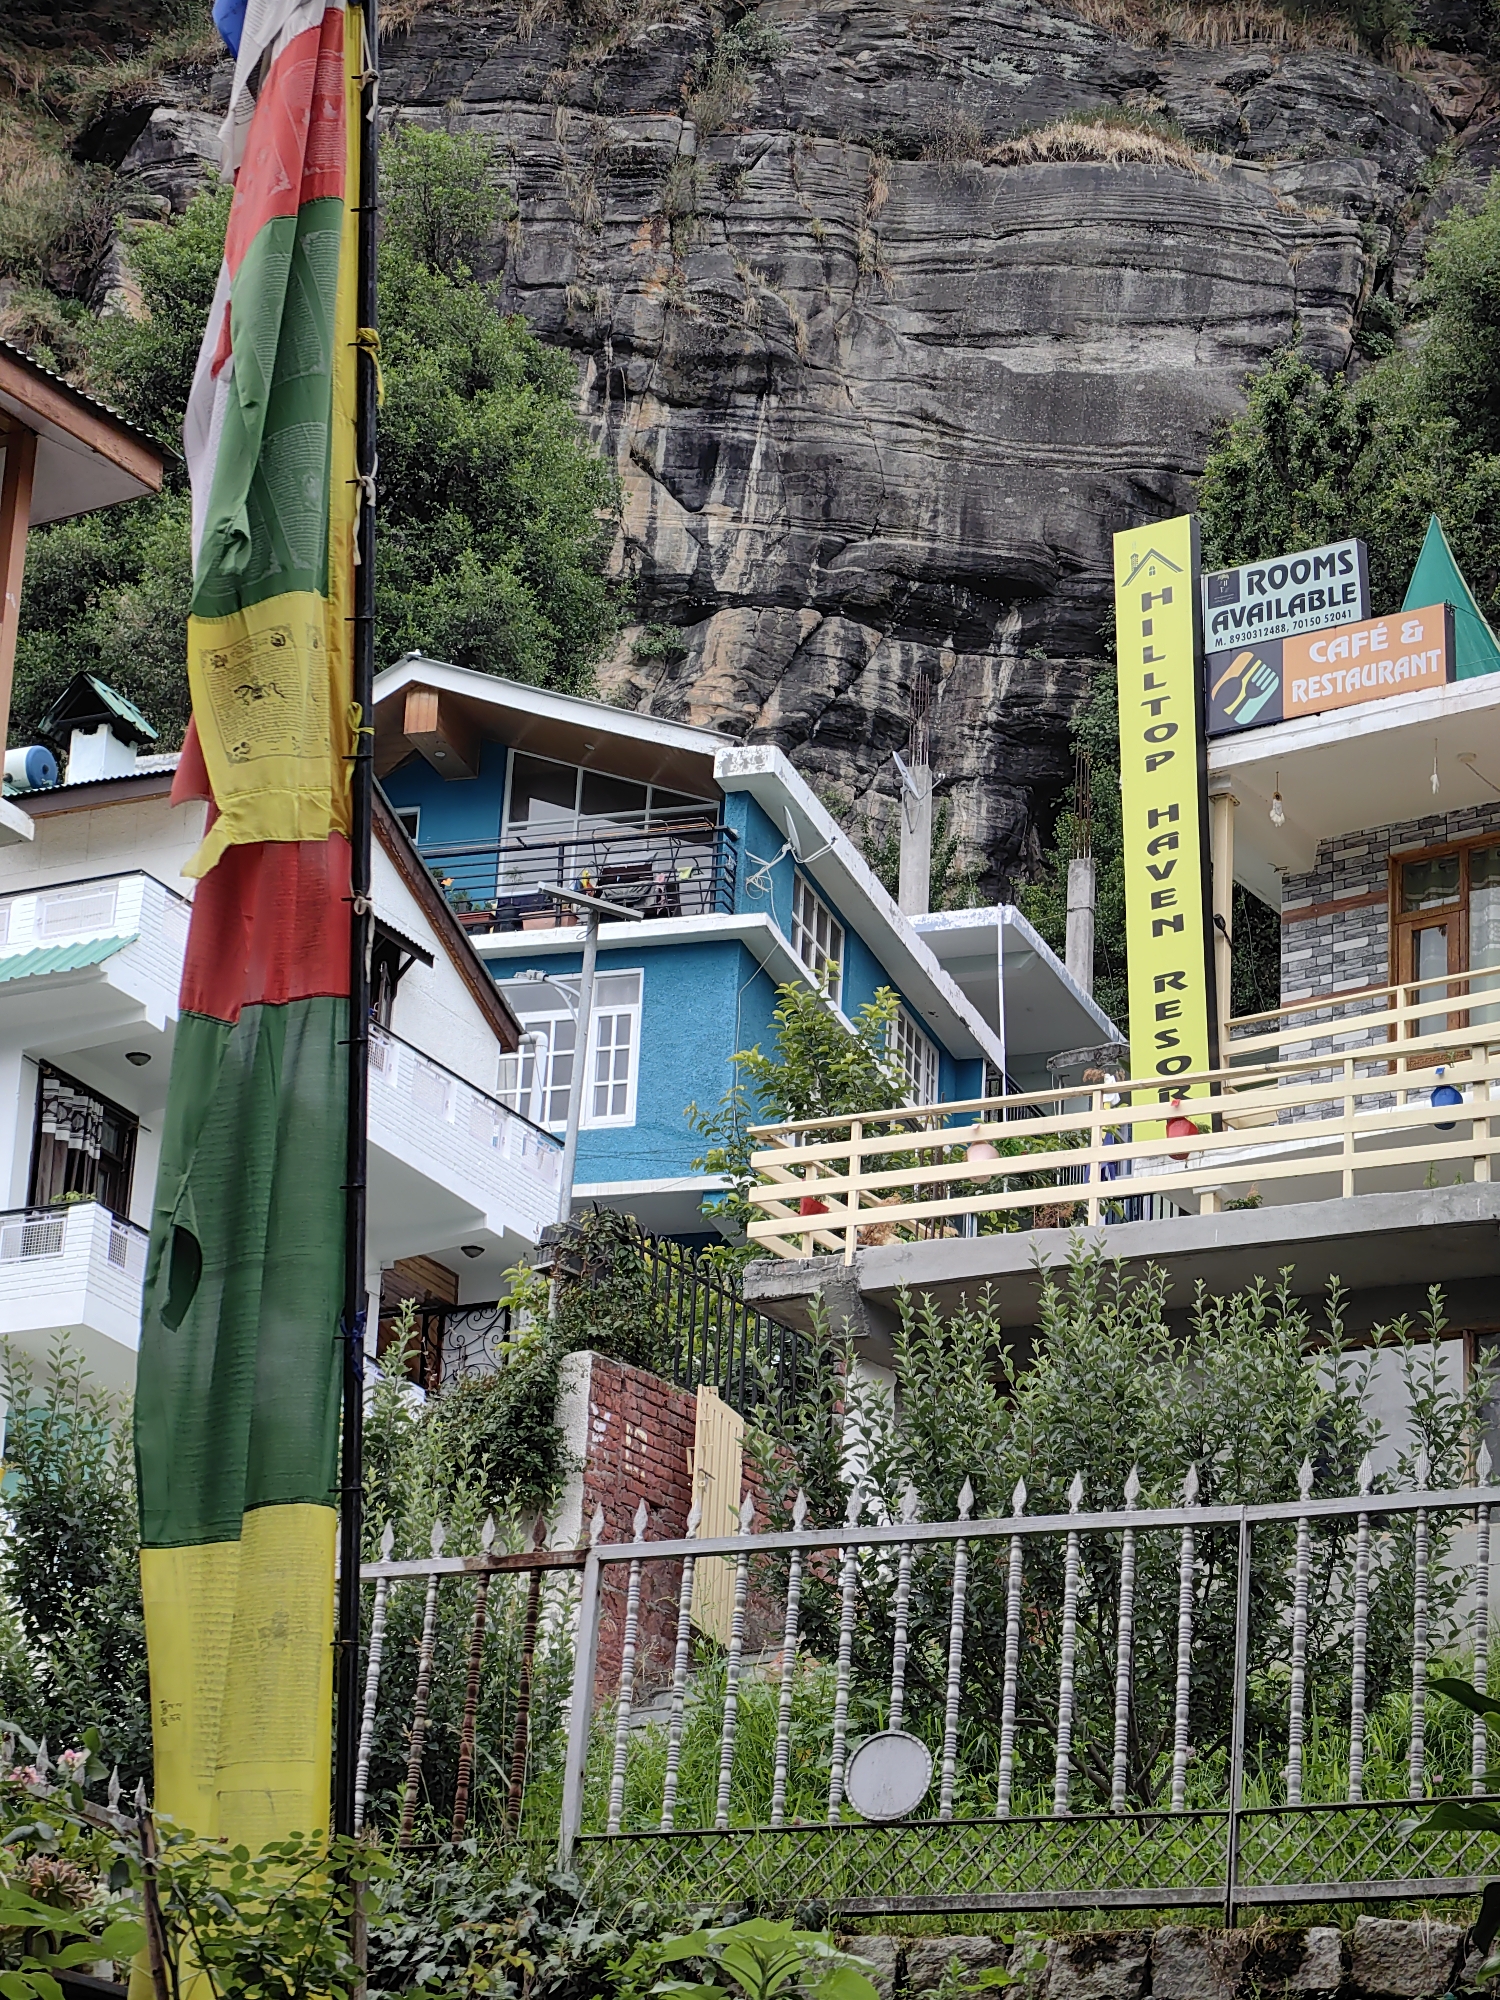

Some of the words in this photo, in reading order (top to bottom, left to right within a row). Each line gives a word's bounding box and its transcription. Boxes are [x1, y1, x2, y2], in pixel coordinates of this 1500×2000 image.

[1247, 549, 1354, 597] ROOMS
[1211, 581, 1358, 635] AVAILABLE
[1214, 638, 1227, 648] M.
[1229, 623, 1290, 644] 8930312488,
[1292, 615, 1321, 630] 70150
[1324, 609, 1352, 624] 52041
[1309, 621, 1389, 664] CAFÉ
[1400, 619, 1424, 644] &
[1140, 586, 1179, 773] HILLTOP
[1291, 649, 1442, 704] RESTAURANT
[1145, 803, 1185, 938] HAVEN
[1153, 970, 1193, 1128] RESOR
